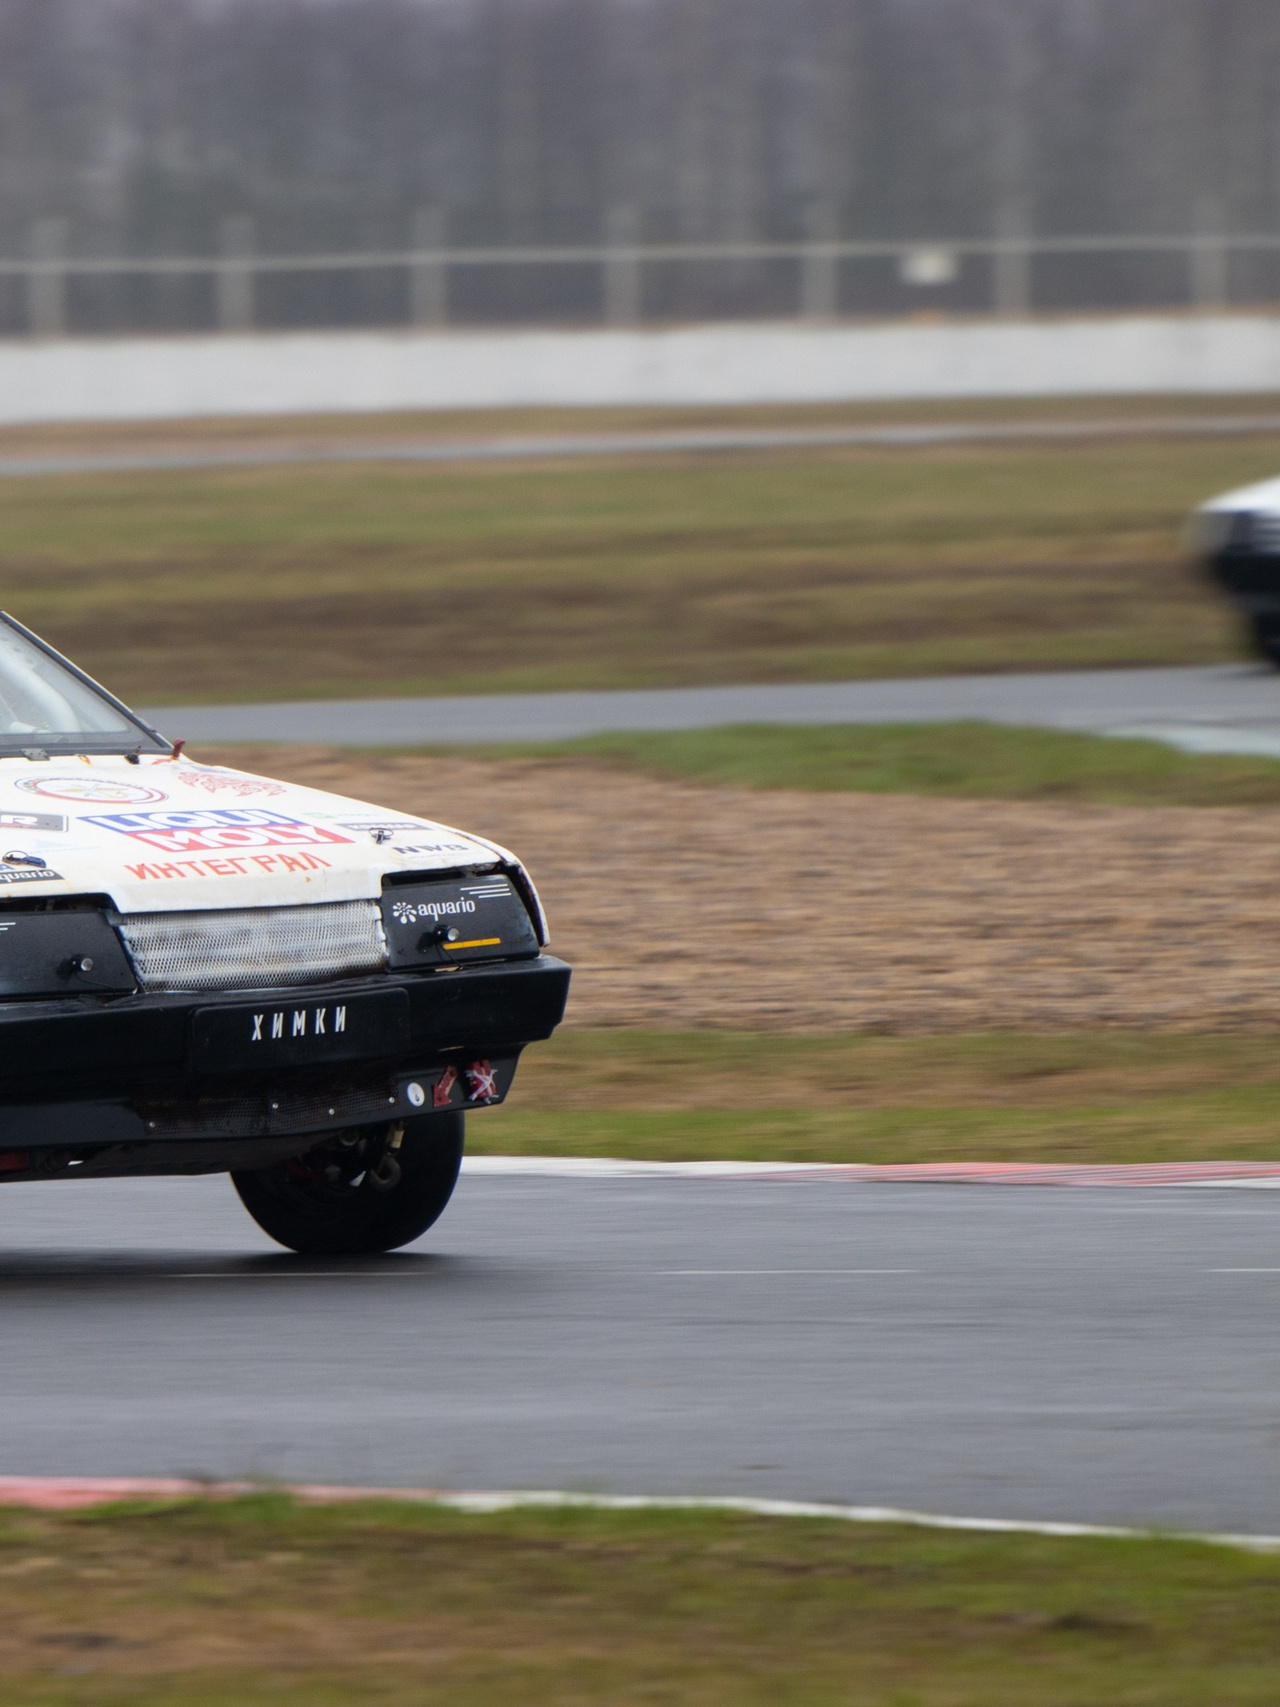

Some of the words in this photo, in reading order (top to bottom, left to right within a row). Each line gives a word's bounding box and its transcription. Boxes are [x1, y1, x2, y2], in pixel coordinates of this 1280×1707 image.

[87, 809, 297, 833] LIQUI
[136, 825, 337, 851] MOLY
[123, 852, 333, 880] ИНТЕГРАЛ
[418, 896, 476, 922] aquario
[251, 1005, 347, 1041] ХИМКИ
